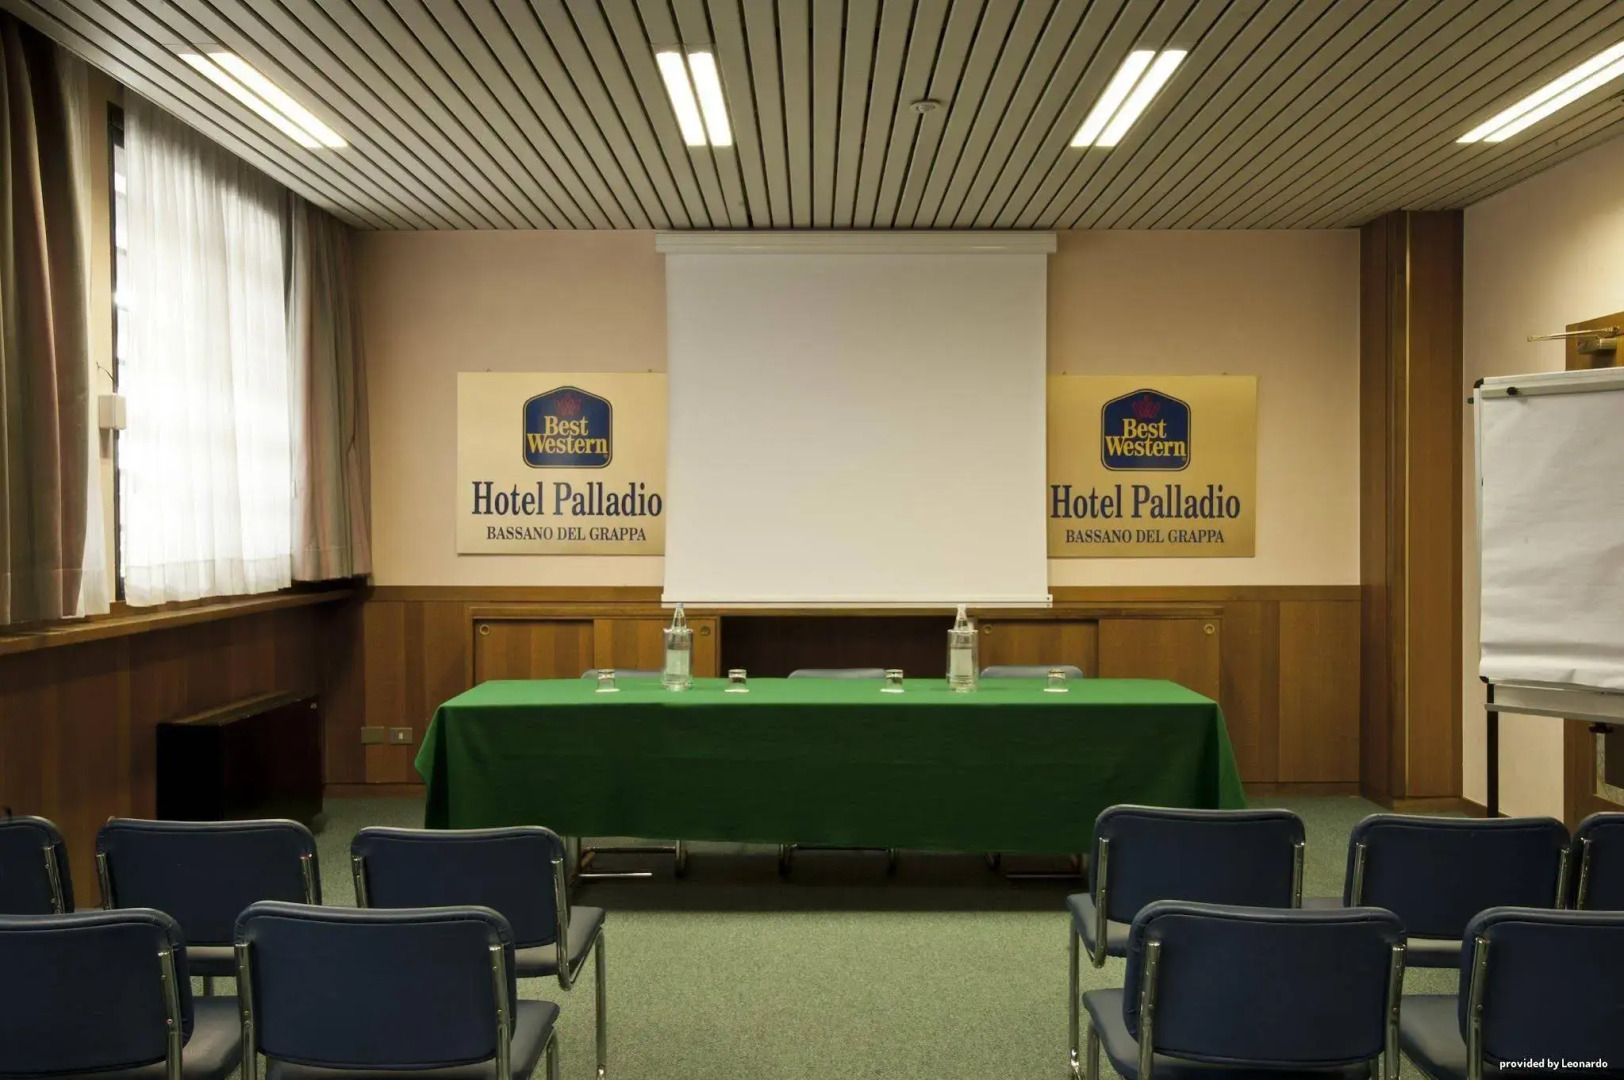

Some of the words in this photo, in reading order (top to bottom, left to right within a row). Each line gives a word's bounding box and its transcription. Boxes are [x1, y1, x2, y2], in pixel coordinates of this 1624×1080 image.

[544, 415, 589, 436] Best
[1122, 418, 1167, 439] Best
[526, 433, 609, 454] Western
[1105, 436, 1187, 457] Western
[471, 481, 545, 516] Hotel
[552, 481, 663, 517] Palladio
[1050, 484, 1123, 519] Hotel
[1131, 484, 1241, 519] Palladio
[486, 526, 553, 541] BASSANO
[557, 526, 586, 541] DEL
[589, 526, 647, 541] GRAPPA
[1065, 529, 1132, 543] BASSANO
[1136, 529, 1164, 543] DEL
[1168, 529, 1225, 543] GRAPPA
